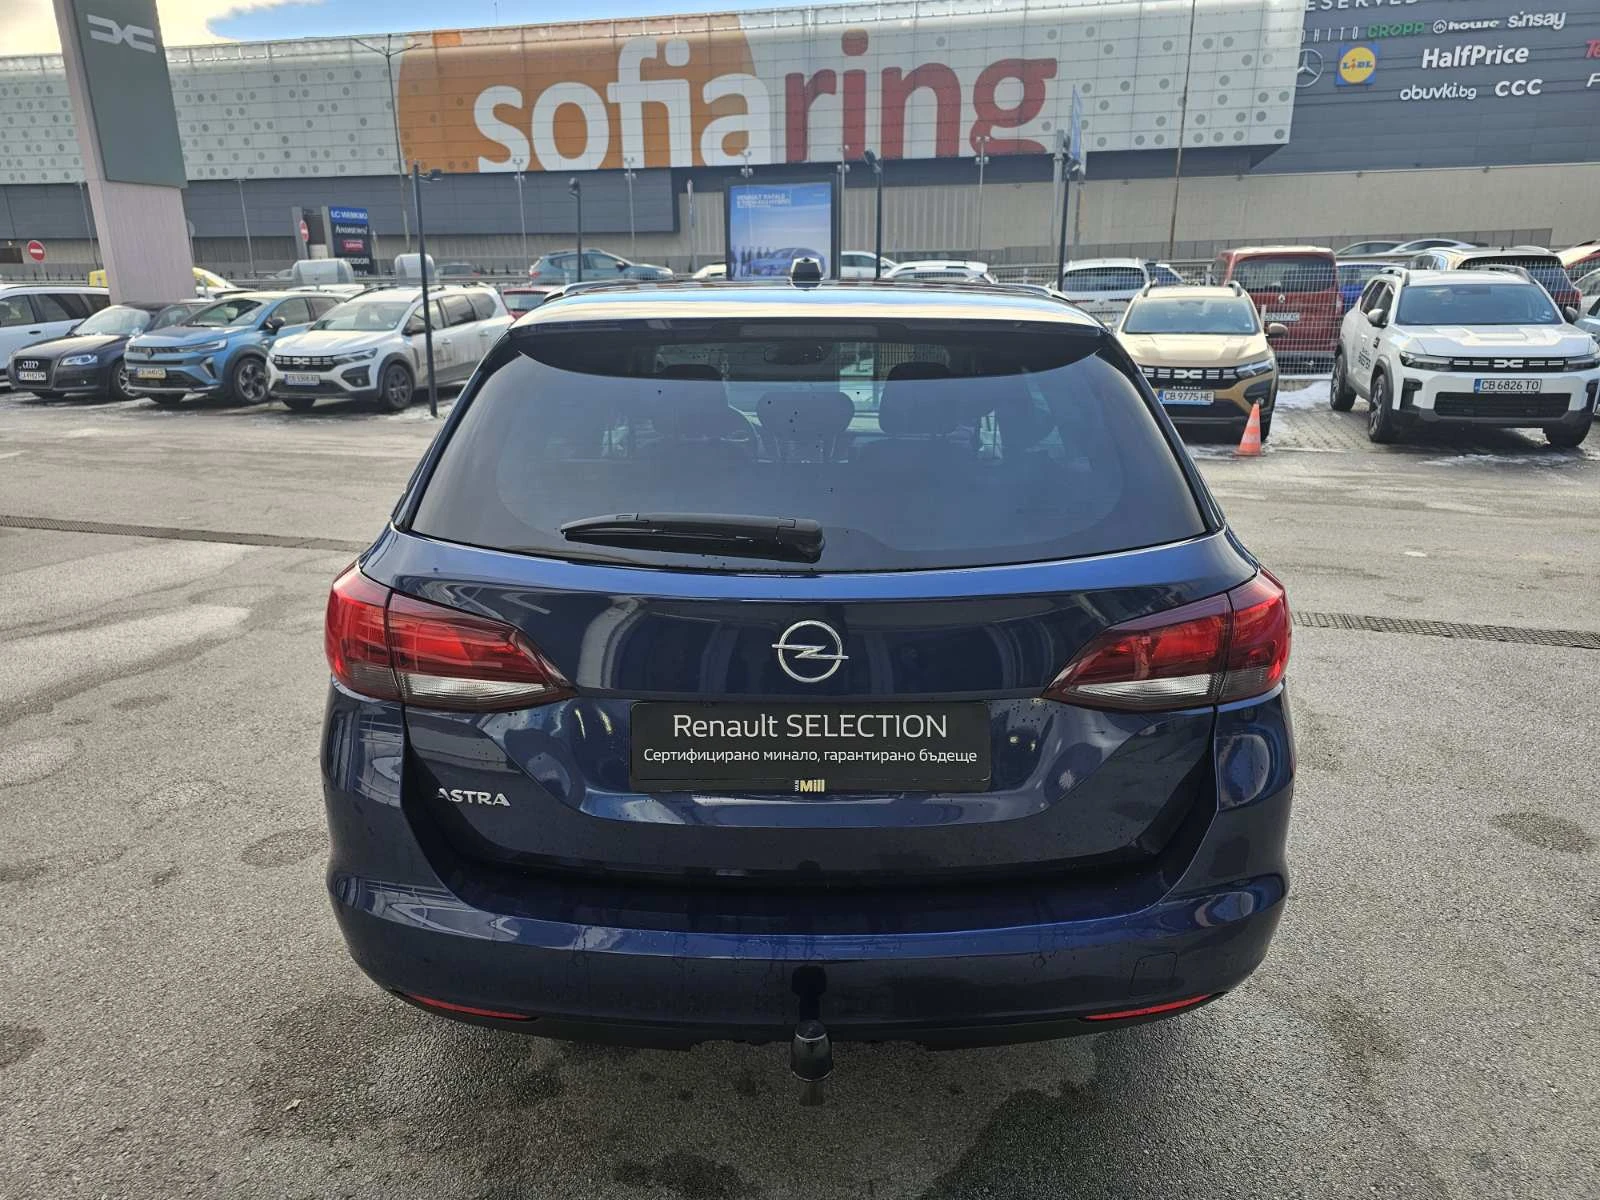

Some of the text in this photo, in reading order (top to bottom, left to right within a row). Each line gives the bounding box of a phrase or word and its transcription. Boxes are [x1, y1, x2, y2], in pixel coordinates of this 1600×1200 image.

[1507, 11, 1567, 30] sinsay
[1422, 45, 1529, 69] HalfPrice
[1400, 83, 1477, 100] obuvki.bg
[1495, 79, 1543, 97] CCC
[1481, 380, 1495, 390] CB
[1497, 380, 1523, 390] 6826
[1178, 391, 1199, 401] 9775
[673, 714, 948, 738] Renault SELECTION
[643, 748, 978, 764] Сертифицирано минало, гарантирано бъдеще
[800, 779, 826, 793] Mill
[437, 787, 511, 807] ASTRA
